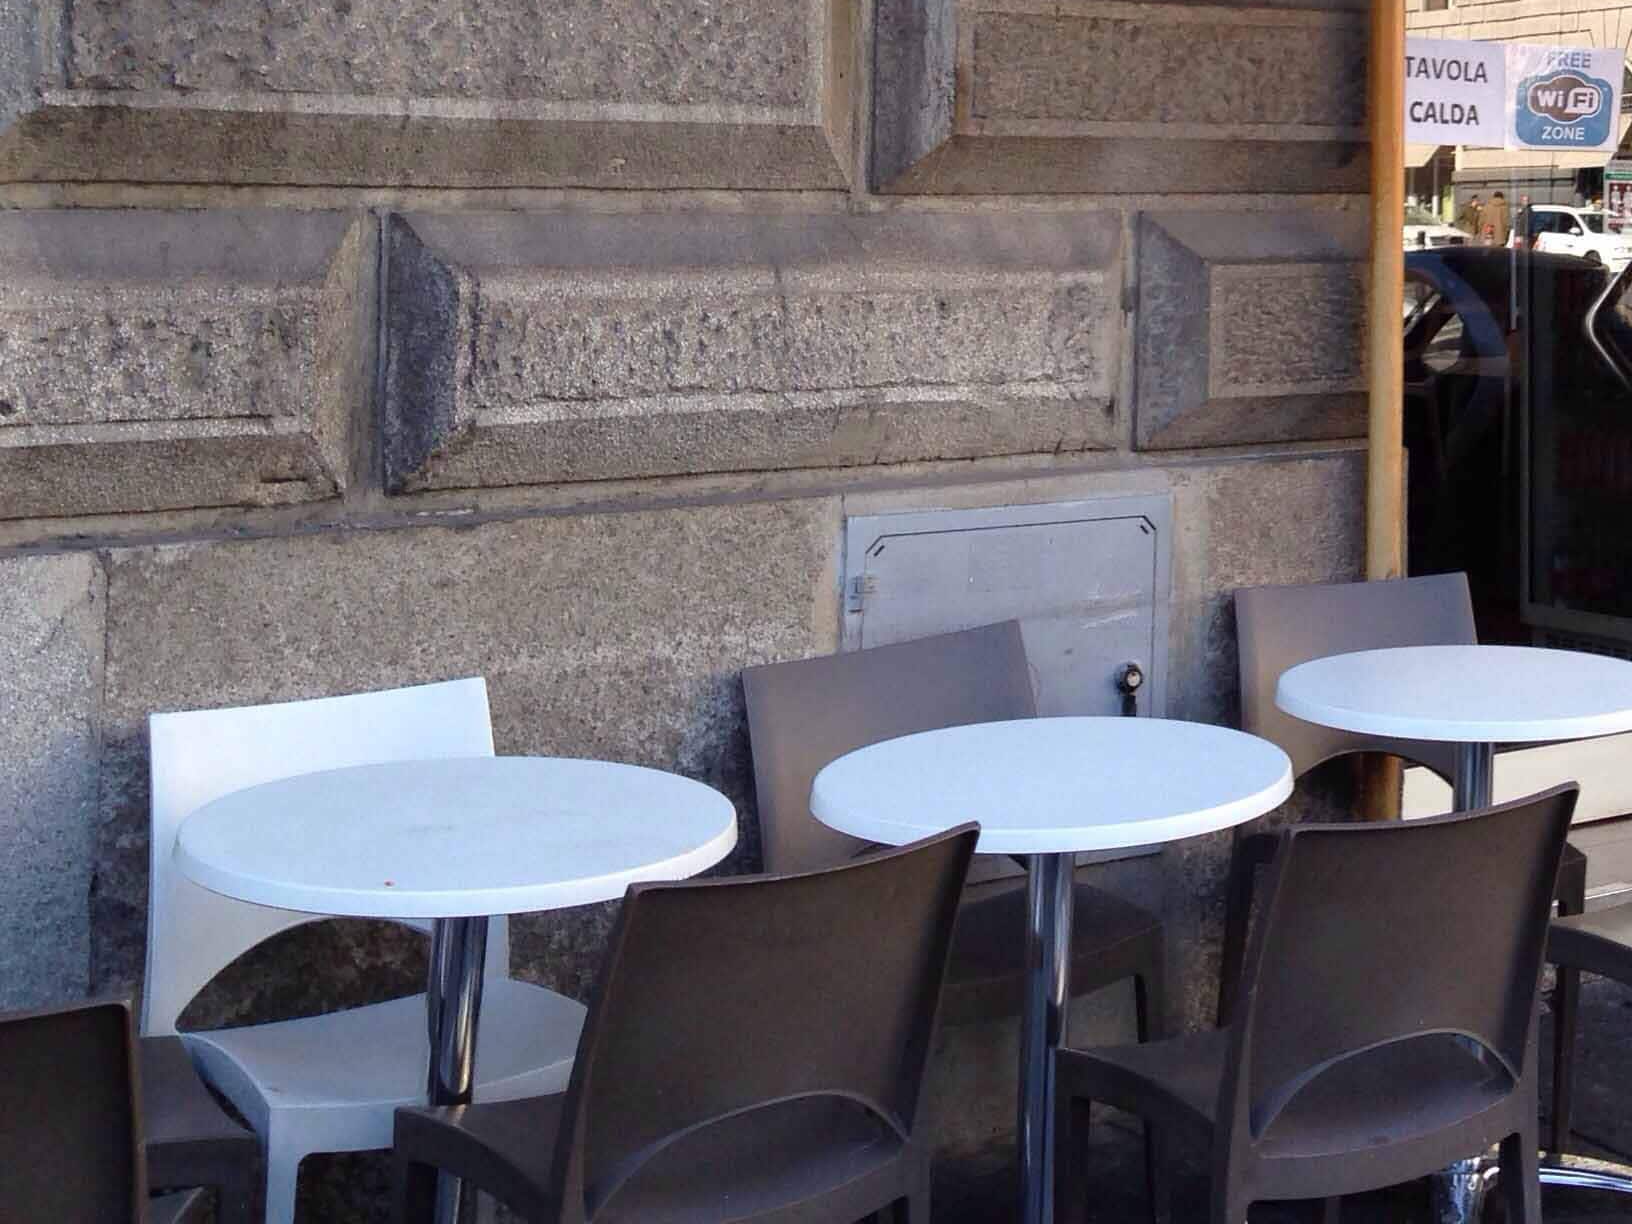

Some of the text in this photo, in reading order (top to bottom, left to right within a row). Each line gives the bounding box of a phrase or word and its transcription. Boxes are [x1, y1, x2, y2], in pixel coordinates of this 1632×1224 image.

[1404, 55, 1489, 84] TAVOLA
[1547, 49, 1592, 69] FREE
[1409, 101, 1480, 126] CALDA
[1541, 126, 1586, 141] ZONE
